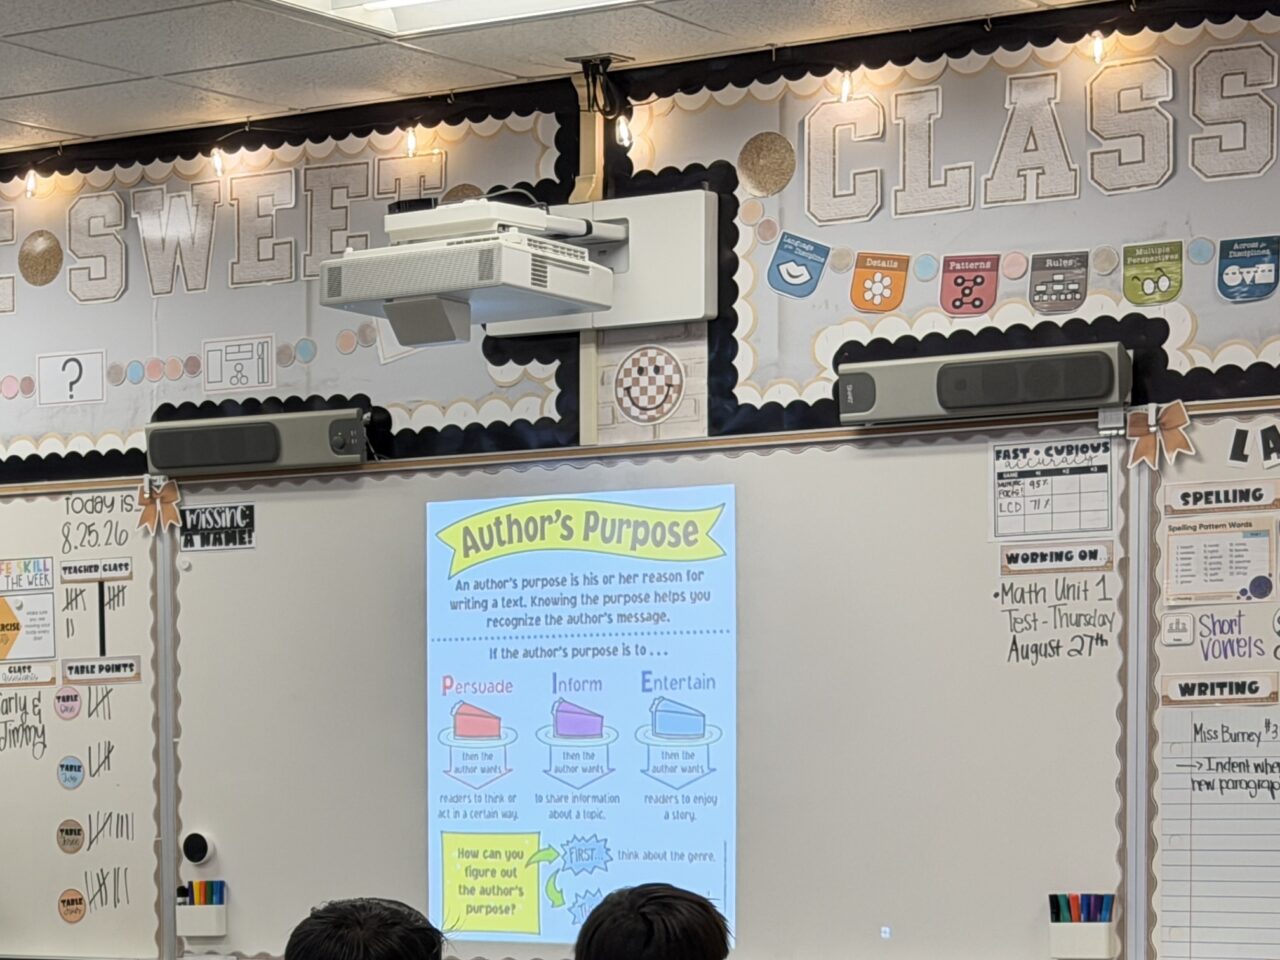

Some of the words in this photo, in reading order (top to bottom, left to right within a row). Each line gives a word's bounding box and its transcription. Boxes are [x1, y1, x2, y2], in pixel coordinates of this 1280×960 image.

[804, 41, 1280, 226] CLASS
[1127, 252, 1179, 264] Perspectives
[1135, 246, 1170, 255] Multiple
[866, 258, 898, 268] Details
[948, 261, 991, 270] Patterns
[1045, 258, 1073, 267] Rules
[995, 447, 1030, 461] FAST
[1044, 441, 1110, 458] CURIOUS
[1004, 454, 1098, 469] accuracy
[1180, 488, 1264, 506] SPELLING
[65, 495, 114, 515] Today
[999, 502, 1022, 513] LCD
[462, 508, 574, 559] Author's
[582, 510, 699, 552] Purpose
[1168, 524, 1197, 533] Spelling
[1198, 522, 1227, 531] Pattern
[1228, 521, 1253, 529] Words
[62, 520, 128, 554] 8.25.26
[1006, 550, 1074, 564] WORKING
[16, 560, 50, 575] SKILL
[62, 564, 100, 575] TEACHER
[102, 562, 130, 572] CLASS
[5, 575, 23, 590] THE
[27, 573, 51, 586] WEEK
[455, 579, 470, 592] An
[473, 577, 518, 591] author's
[521, 576, 567, 591] purpose
[570, 573, 580, 588] is
[582, 572, 599, 587] his
[602, 574, 615, 586] or
[618, 571, 638, 585] her
[642, 572, 682, 584] reason
[686, 570, 705, 583] for
[1001, 582, 1047, 605] Math
[1055, 577, 1089, 602] Unit
[1096, 574, 1113, 601] 1
[450, 598, 488, 612] writing
[492, 599, 498, 609] a
[501, 596, 528, 609] text.
[530, 593, 578, 609] Knowing
[581, 592, 600, 606] the
[602, 592, 651, 607] purpose
[654, 590, 686, 604] helps
[690, 590, 711, 604] you
[486, 613, 542, 631] recognize
[544, 613, 564, 626] the
[567, 611, 614, 625] author's
[616, 611, 671, 625] message.
[1198, 609, 1246, 638] Short
[489, 647, 499, 660] If
[501, 647, 520, 660] the
[522, 645, 568, 659] author's
[572, 646, 618, 660] purpose
[622, 644, 631, 656] is
[1007, 634, 1063, 666] August
[1066, 632, 1108, 658] 27th
[68, 664, 96, 675] TABLE
[98, 662, 135, 674] POINTS
[441, 675, 514, 696] Persuade
[551, 672, 602, 694] Inform
[641, 670, 716, 693] Entertain
[1178, 680, 1260, 698] WRITING
[56, 694, 78, 703] TABLE
[1194, 722, 1218, 743] Miss
[562, 751, 580, 761] then
[583, 751, 596, 761] the
[60, 764, 82, 772] TABLE
[554, 764, 578, 774] author
[581, 764, 604, 774] wants
[1206, 756, 1250, 774] Indent
[1191, 778, 1215, 792] new
[535, 792, 544, 804] to
[546, 792, 569, 804] share
[571, 792, 620, 804] information
[60, 828, 82, 836] TABLE
[457, 848, 480, 860] How
[483, 850, 502, 860] can
[505, 850, 524, 864] you
[618, 850, 640, 861] think
[642, 849, 668, 862] about
[670, 850, 685, 862] the
[688, 850, 716, 863] genre.
[464, 866, 498, 880] figure
[500, 866, 518, 878] out
[458, 884, 476, 896] the
[479, 884, 524, 896] author's
[61, 898, 82, 907] TABLE
[466, 903, 516, 916] purpose?
